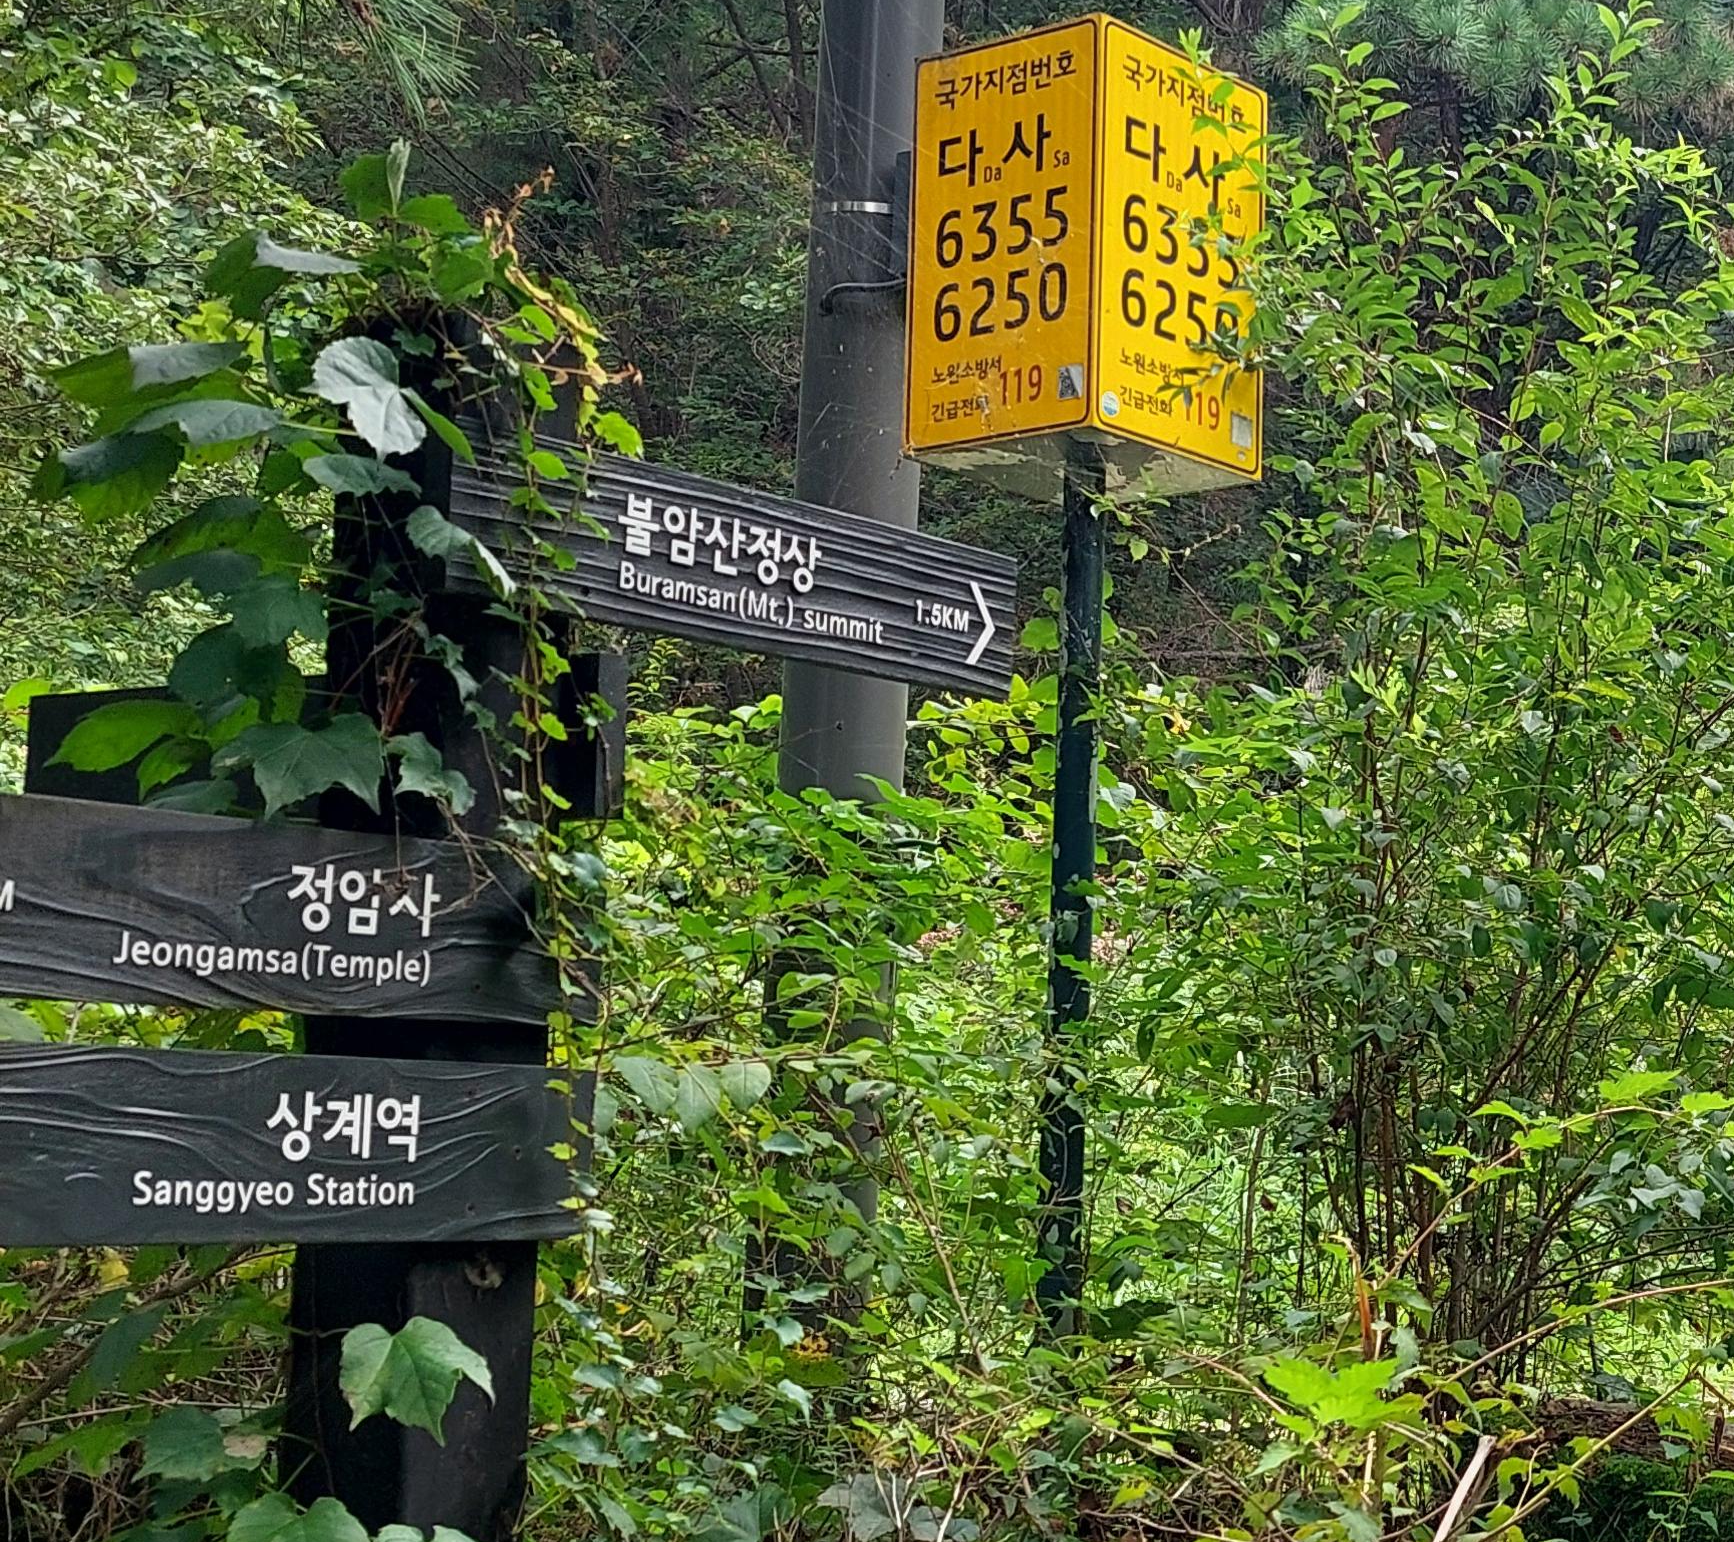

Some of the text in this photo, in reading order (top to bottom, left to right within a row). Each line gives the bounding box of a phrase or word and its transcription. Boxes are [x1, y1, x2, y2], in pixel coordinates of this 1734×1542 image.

[934, 50, 1077, 110] 국가지점번호
[938, 113, 1071, 187] 다 Da 사 Sa
[1125, 114, 1167, 182] 다
[1166, 171, 1183, 193] Da
[935, 185, 1069, 269] 6355
[933, 262, 1068, 343] 6250
[931, 355, 1002, 385] 노원소방서
[1000, 364, 1042, 406] 119
[617, 492, 823, 594] 불암산정상
[619, 560, 884, 644] Buramsan(Mt.) summit
[915, 599, 970, 633] 1.5KM
[287, 863, 442, 938] 정암사
[112, 929, 431, 988] Jeongamsa(Temple)
[265, 1091, 421, 1163] 상계역
[132, 1170, 415, 1214] Sanggyeo Station
